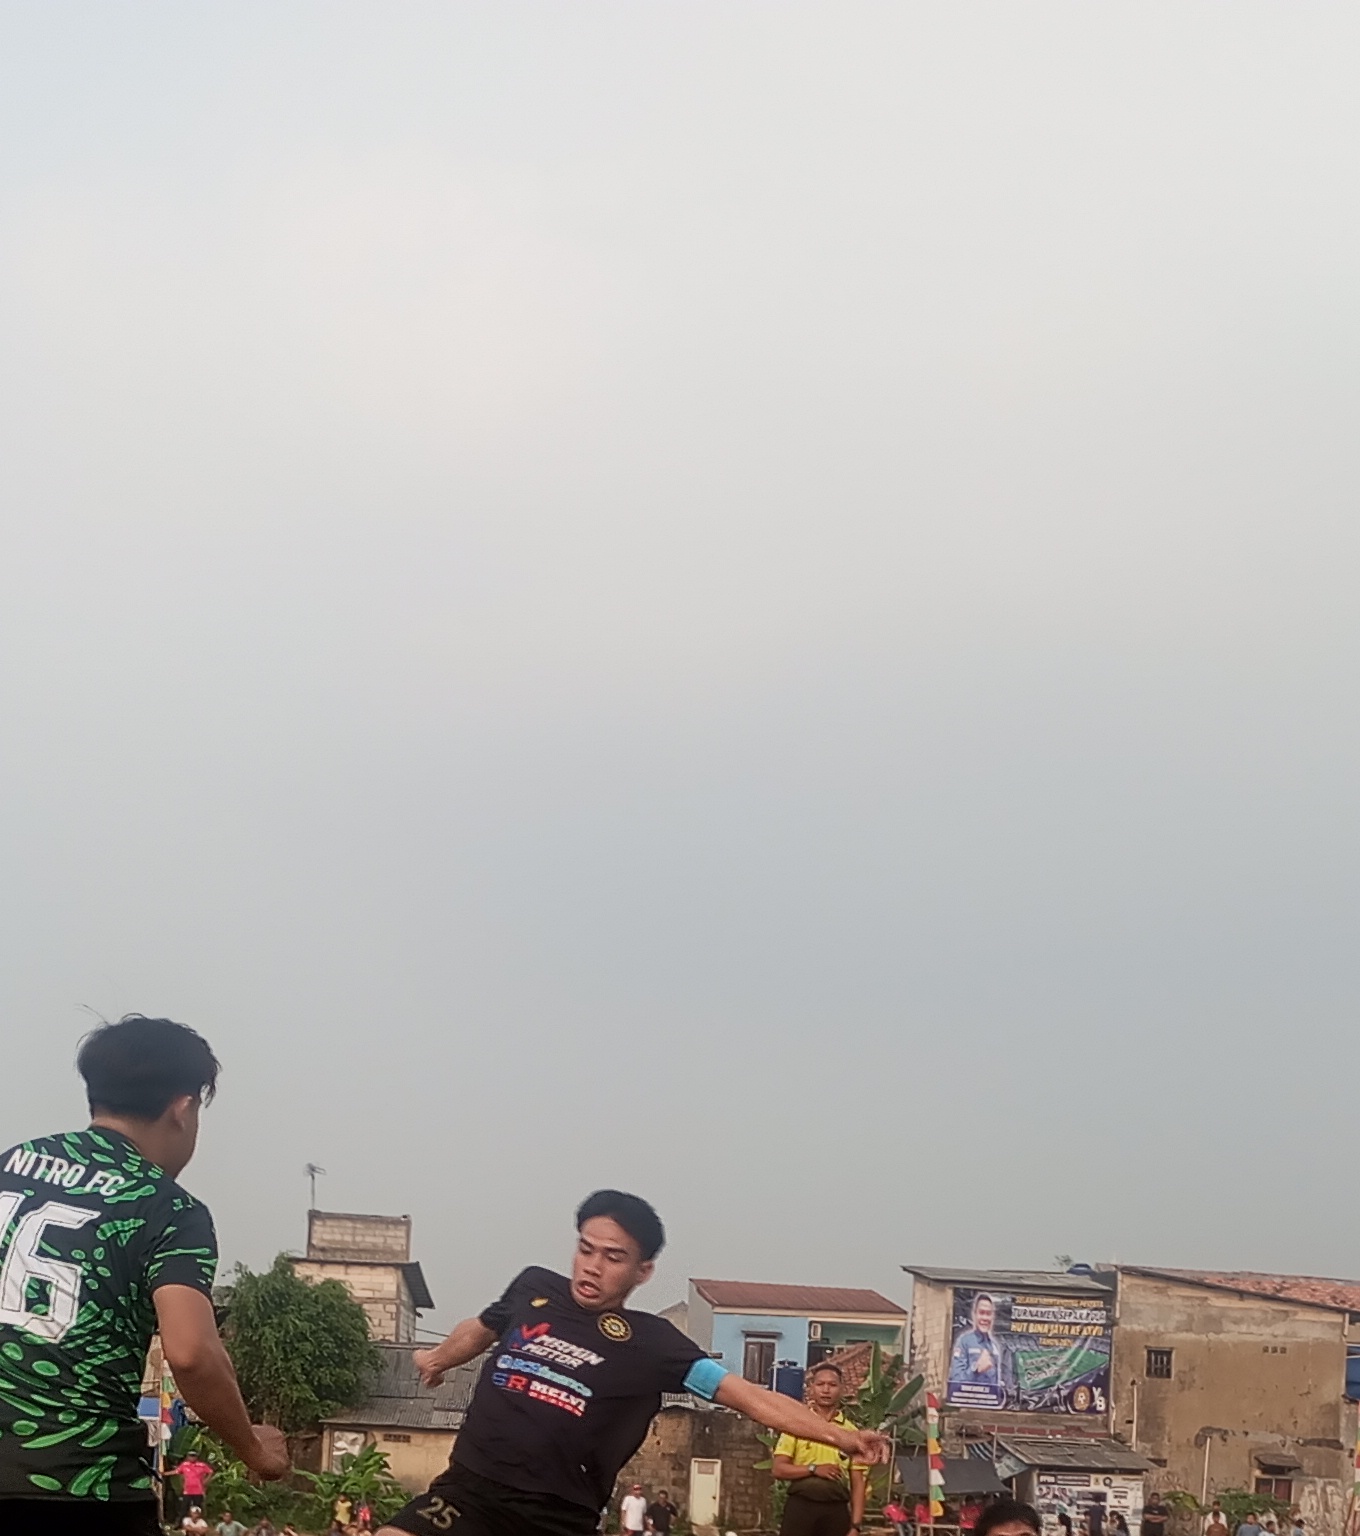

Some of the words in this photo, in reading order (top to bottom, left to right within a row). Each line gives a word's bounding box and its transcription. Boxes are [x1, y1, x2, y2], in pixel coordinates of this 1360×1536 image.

[3, 1148, 86, 1188] NITRO
[83, 1170, 126, 1196] FC
[1012, 1306, 1058, 1321] TURNAMEN
[1058, 1309, 1085, 1323] SEPAK
[1011, 1322, 1028, 1333] HUT
[1048, 1324, 1069, 1337] JAYA
[521, 1342, 584, 1368] MOTOR
[416, 1496, 461, 1530] 25
